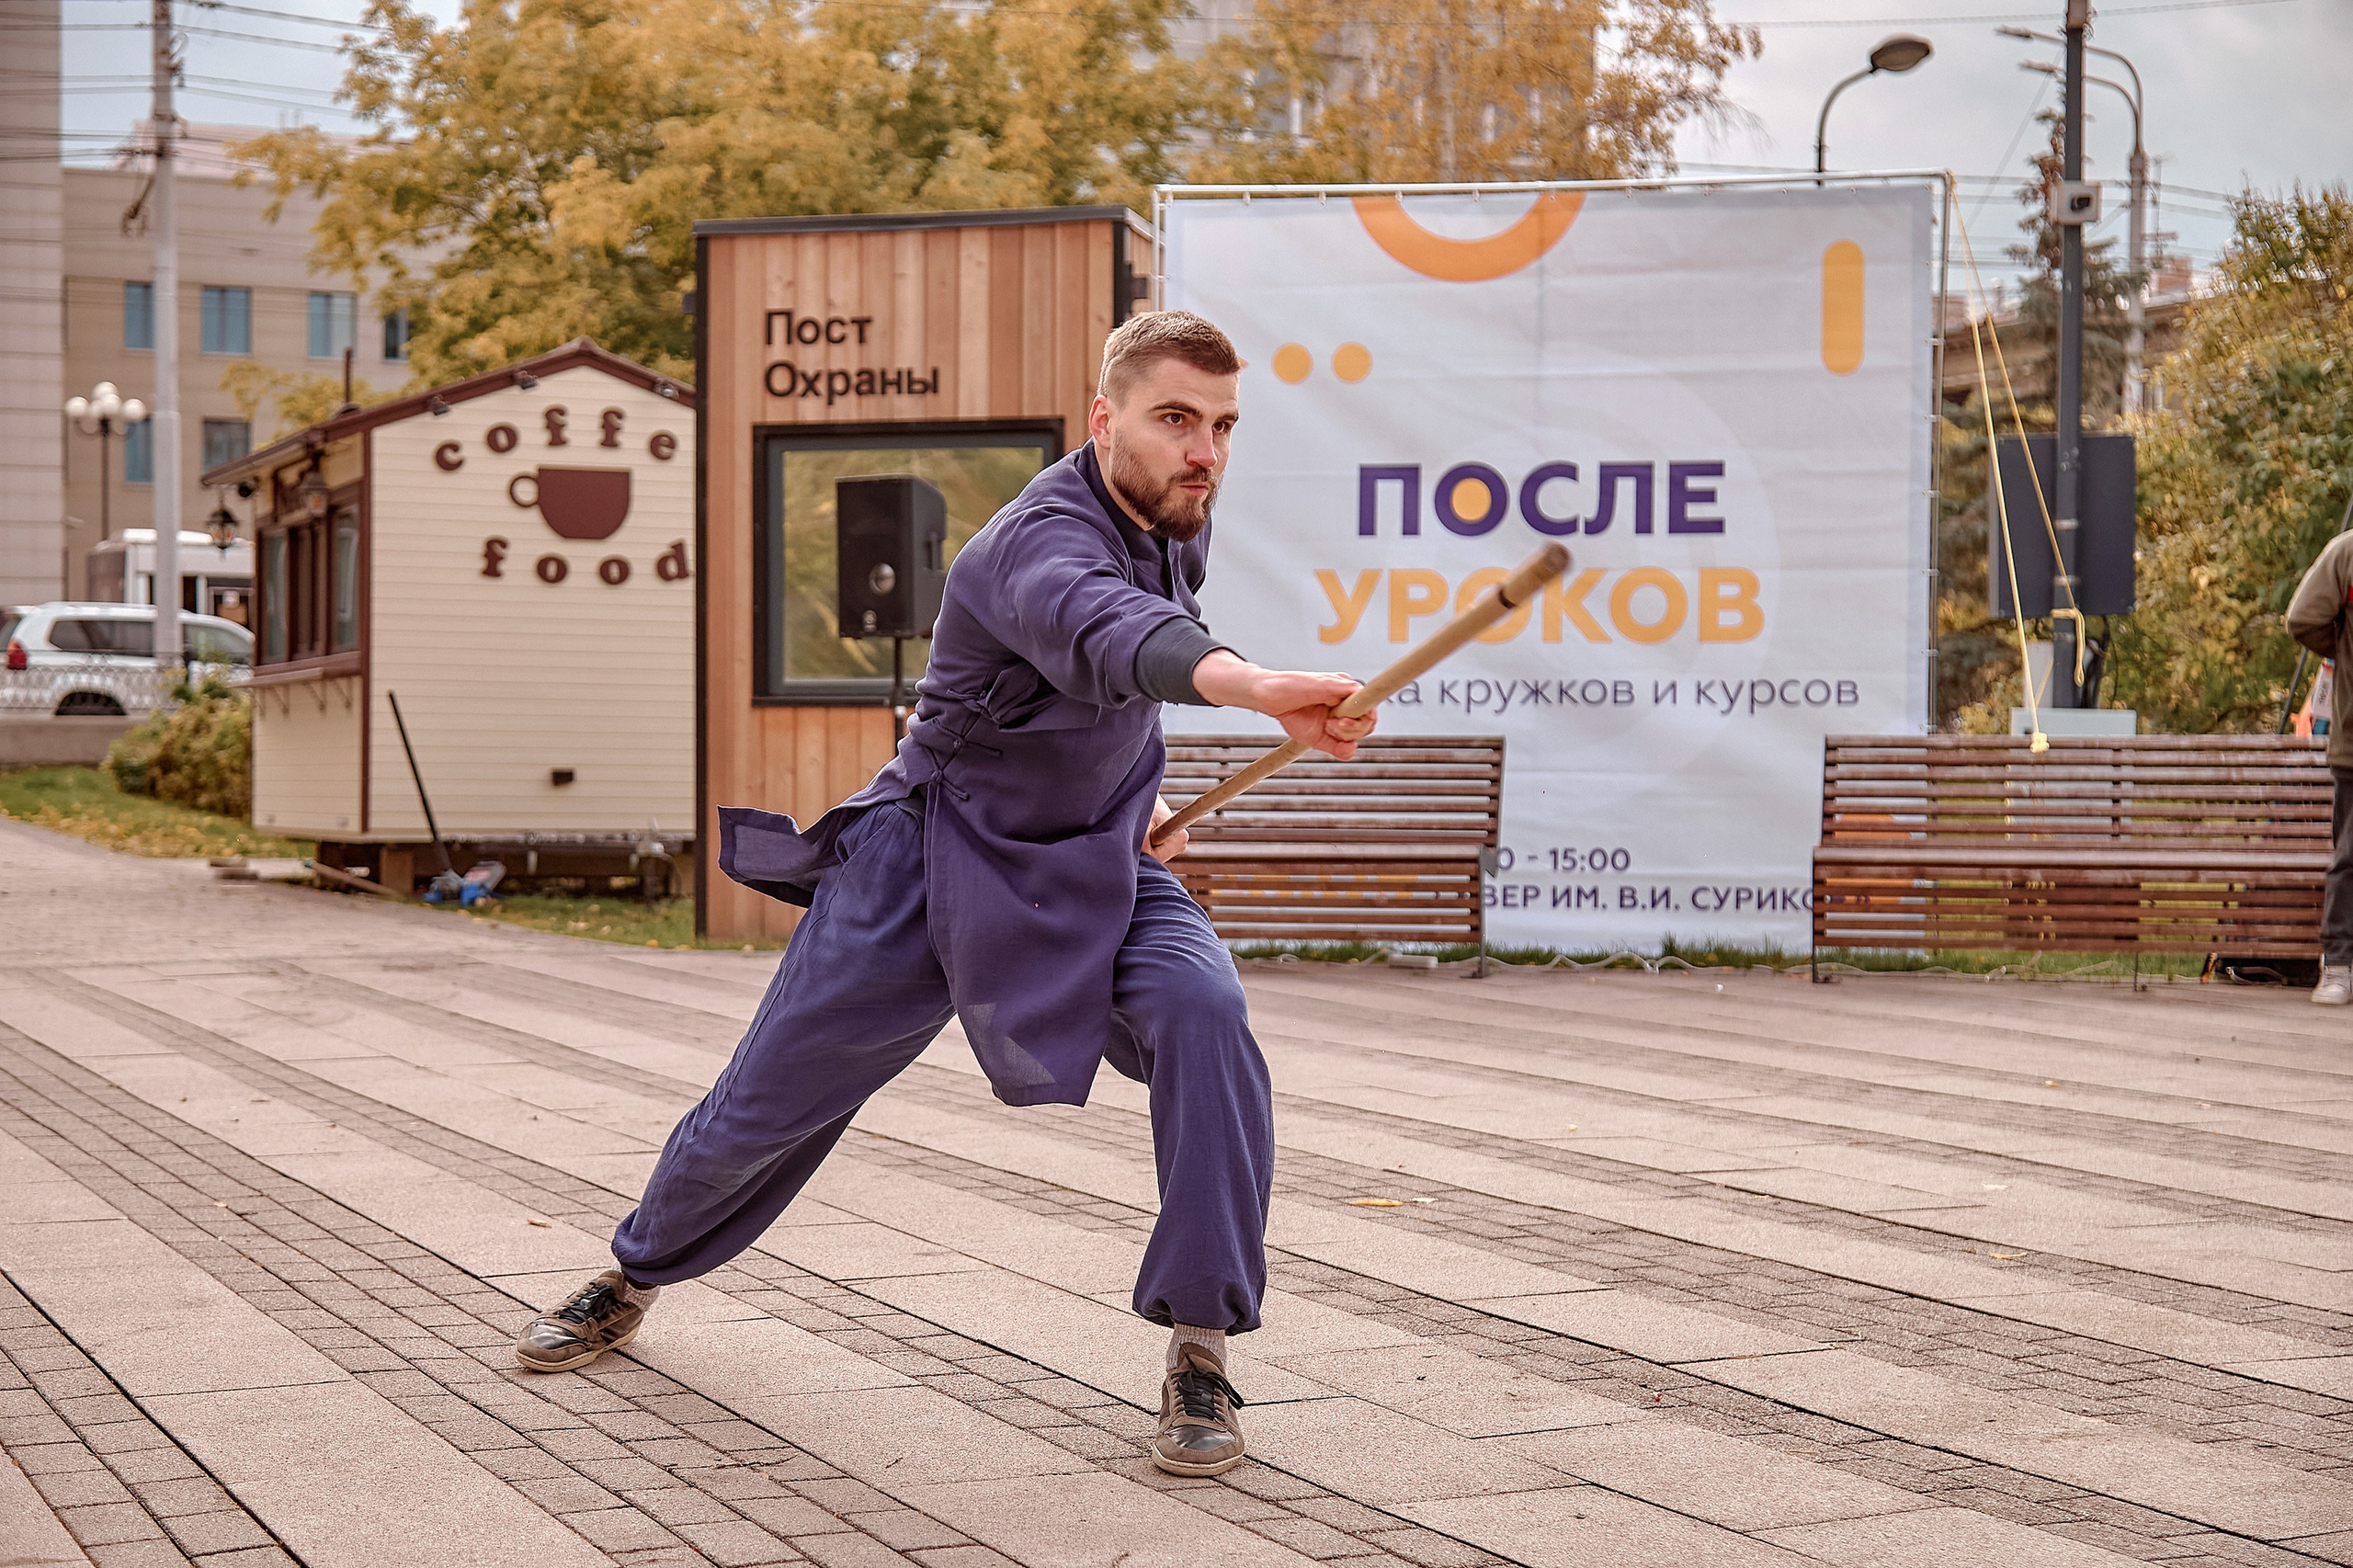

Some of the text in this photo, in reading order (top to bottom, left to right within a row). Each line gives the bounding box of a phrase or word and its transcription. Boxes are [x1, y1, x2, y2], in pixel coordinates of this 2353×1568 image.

[765, 311, 872, 345] Пост
[765, 361, 939, 406] Охраны
[435, 407, 676, 472] coffe
[1358, 460, 1726, 537] ПОСЛЕ
[482, 539, 690, 585] food
[1313, 566, 1766, 643] УРОКОВ
[1438, 678, 1636, 714] кружков
[1654, 679, 1678, 705] и
[1696, 678, 1859, 715] курсов
[1549, 847, 1632, 872] 15:00
[1483, 884, 1541, 909] ВЕР
[1552, 885, 1607, 909] ИМ.
[1619, 885, 1680, 909] В.И.
